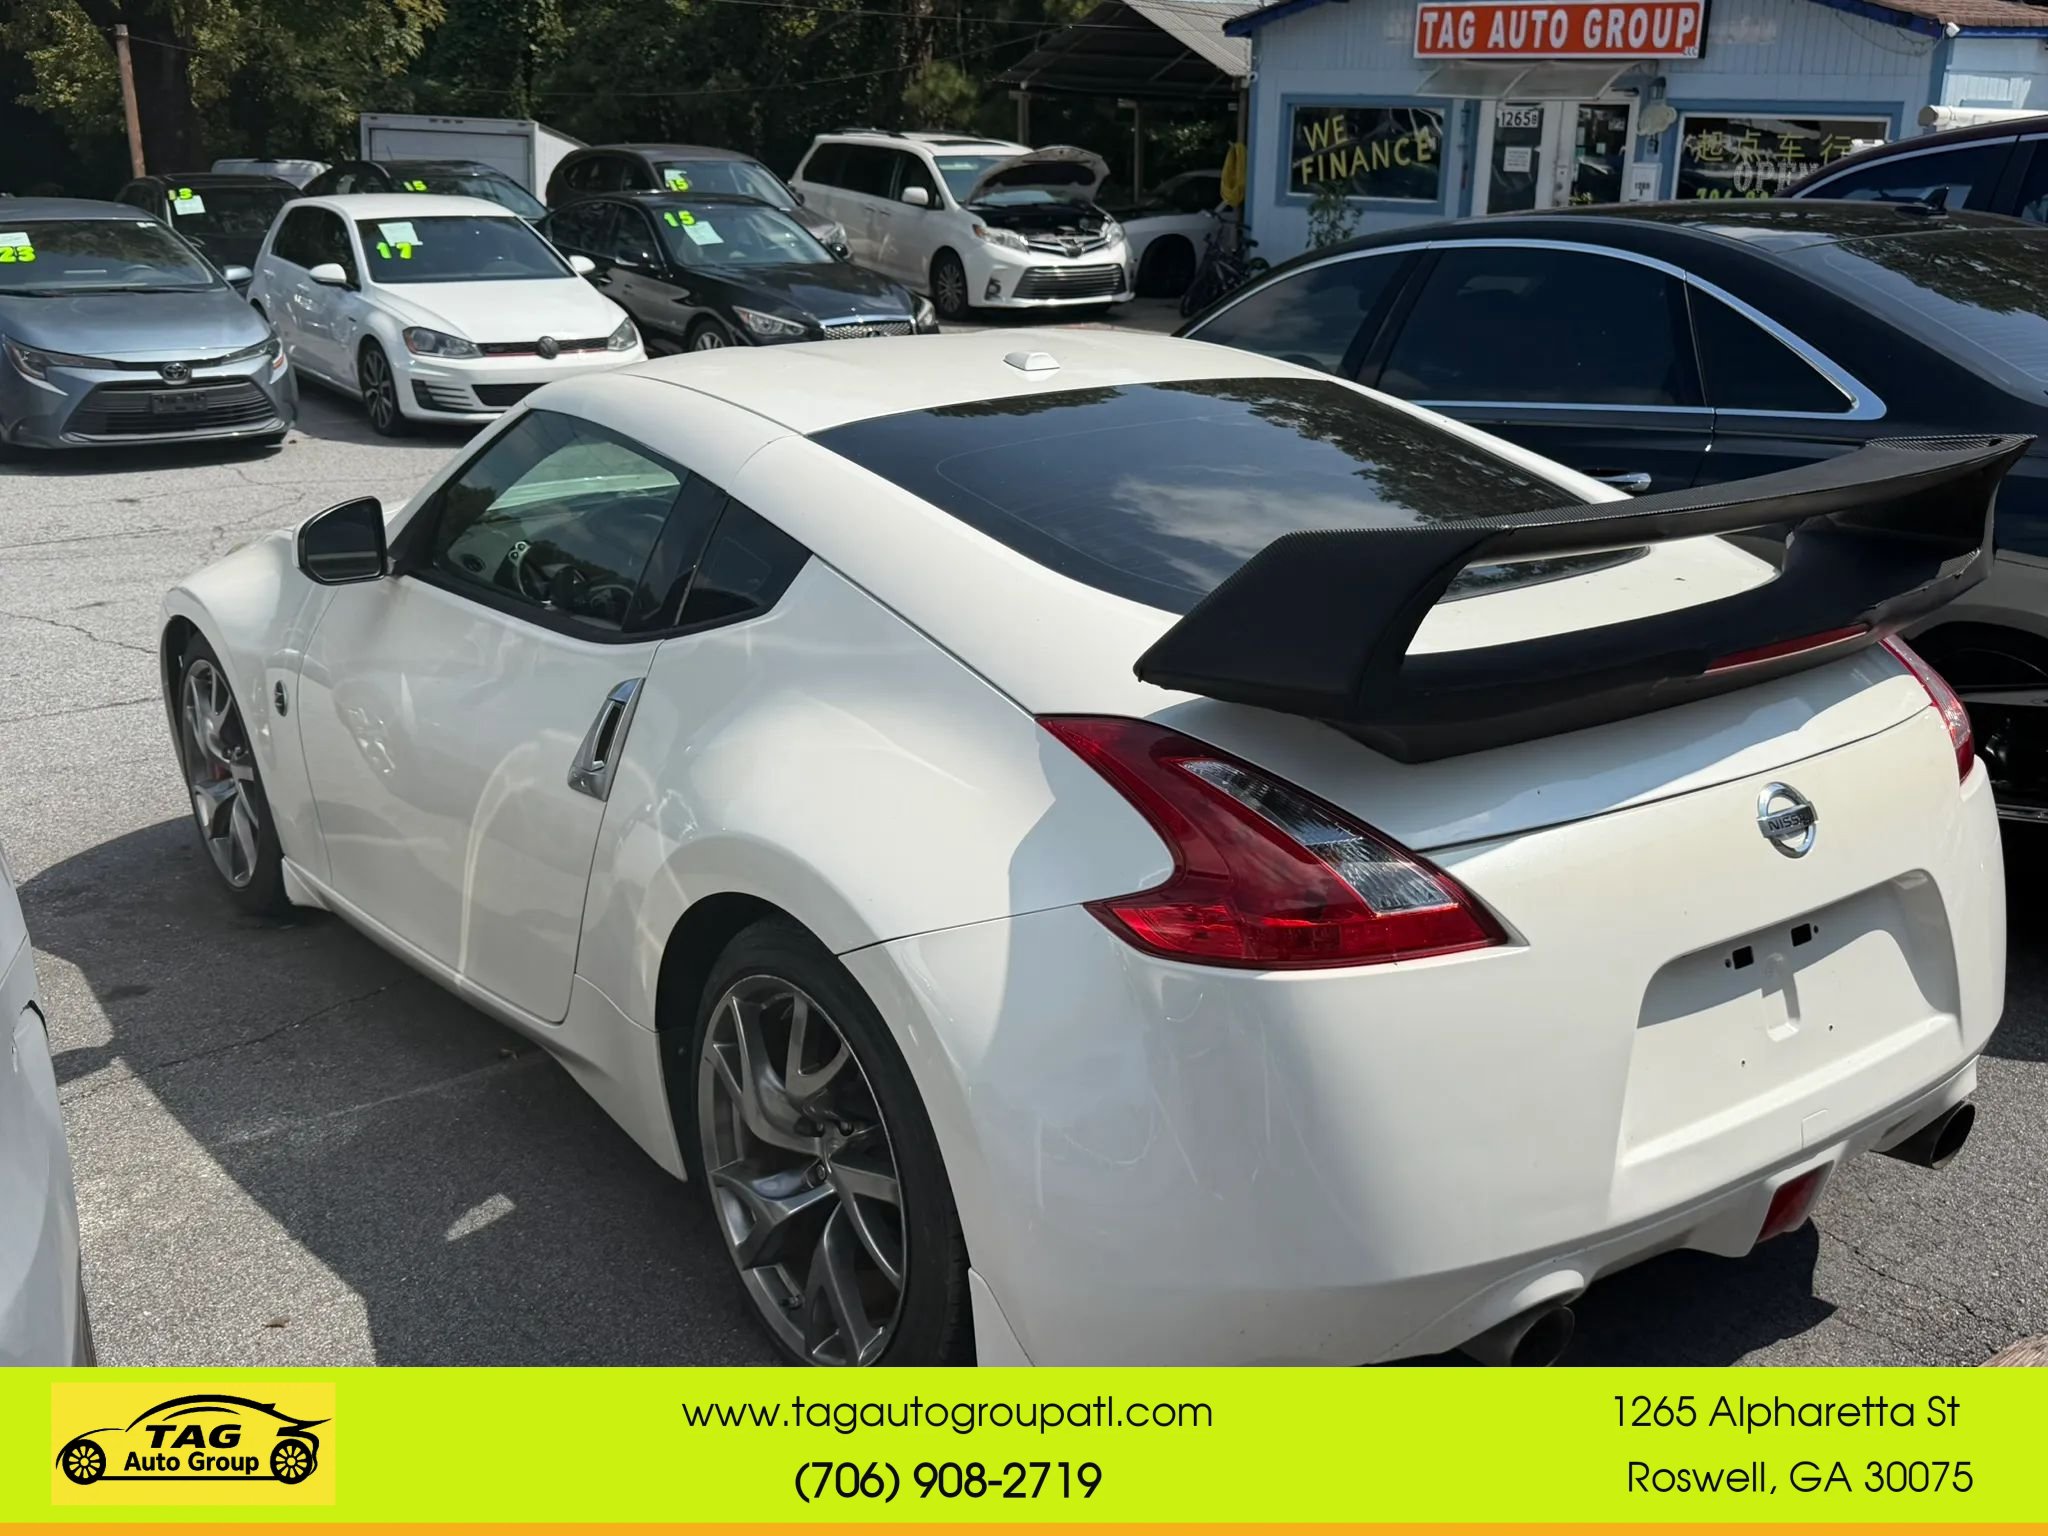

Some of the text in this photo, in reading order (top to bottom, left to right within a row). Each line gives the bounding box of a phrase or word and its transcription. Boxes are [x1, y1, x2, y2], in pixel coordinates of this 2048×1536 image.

[1422, 7, 1695, 49] TAG AUTO GROUP
[1303, 114, 1348, 151] WE
[1302, 129, 1431, 185] FINANCE
[663, 210, 695, 228] 15
[0, 245, 36, 263] 23
[376, 241, 412, 259] 17
